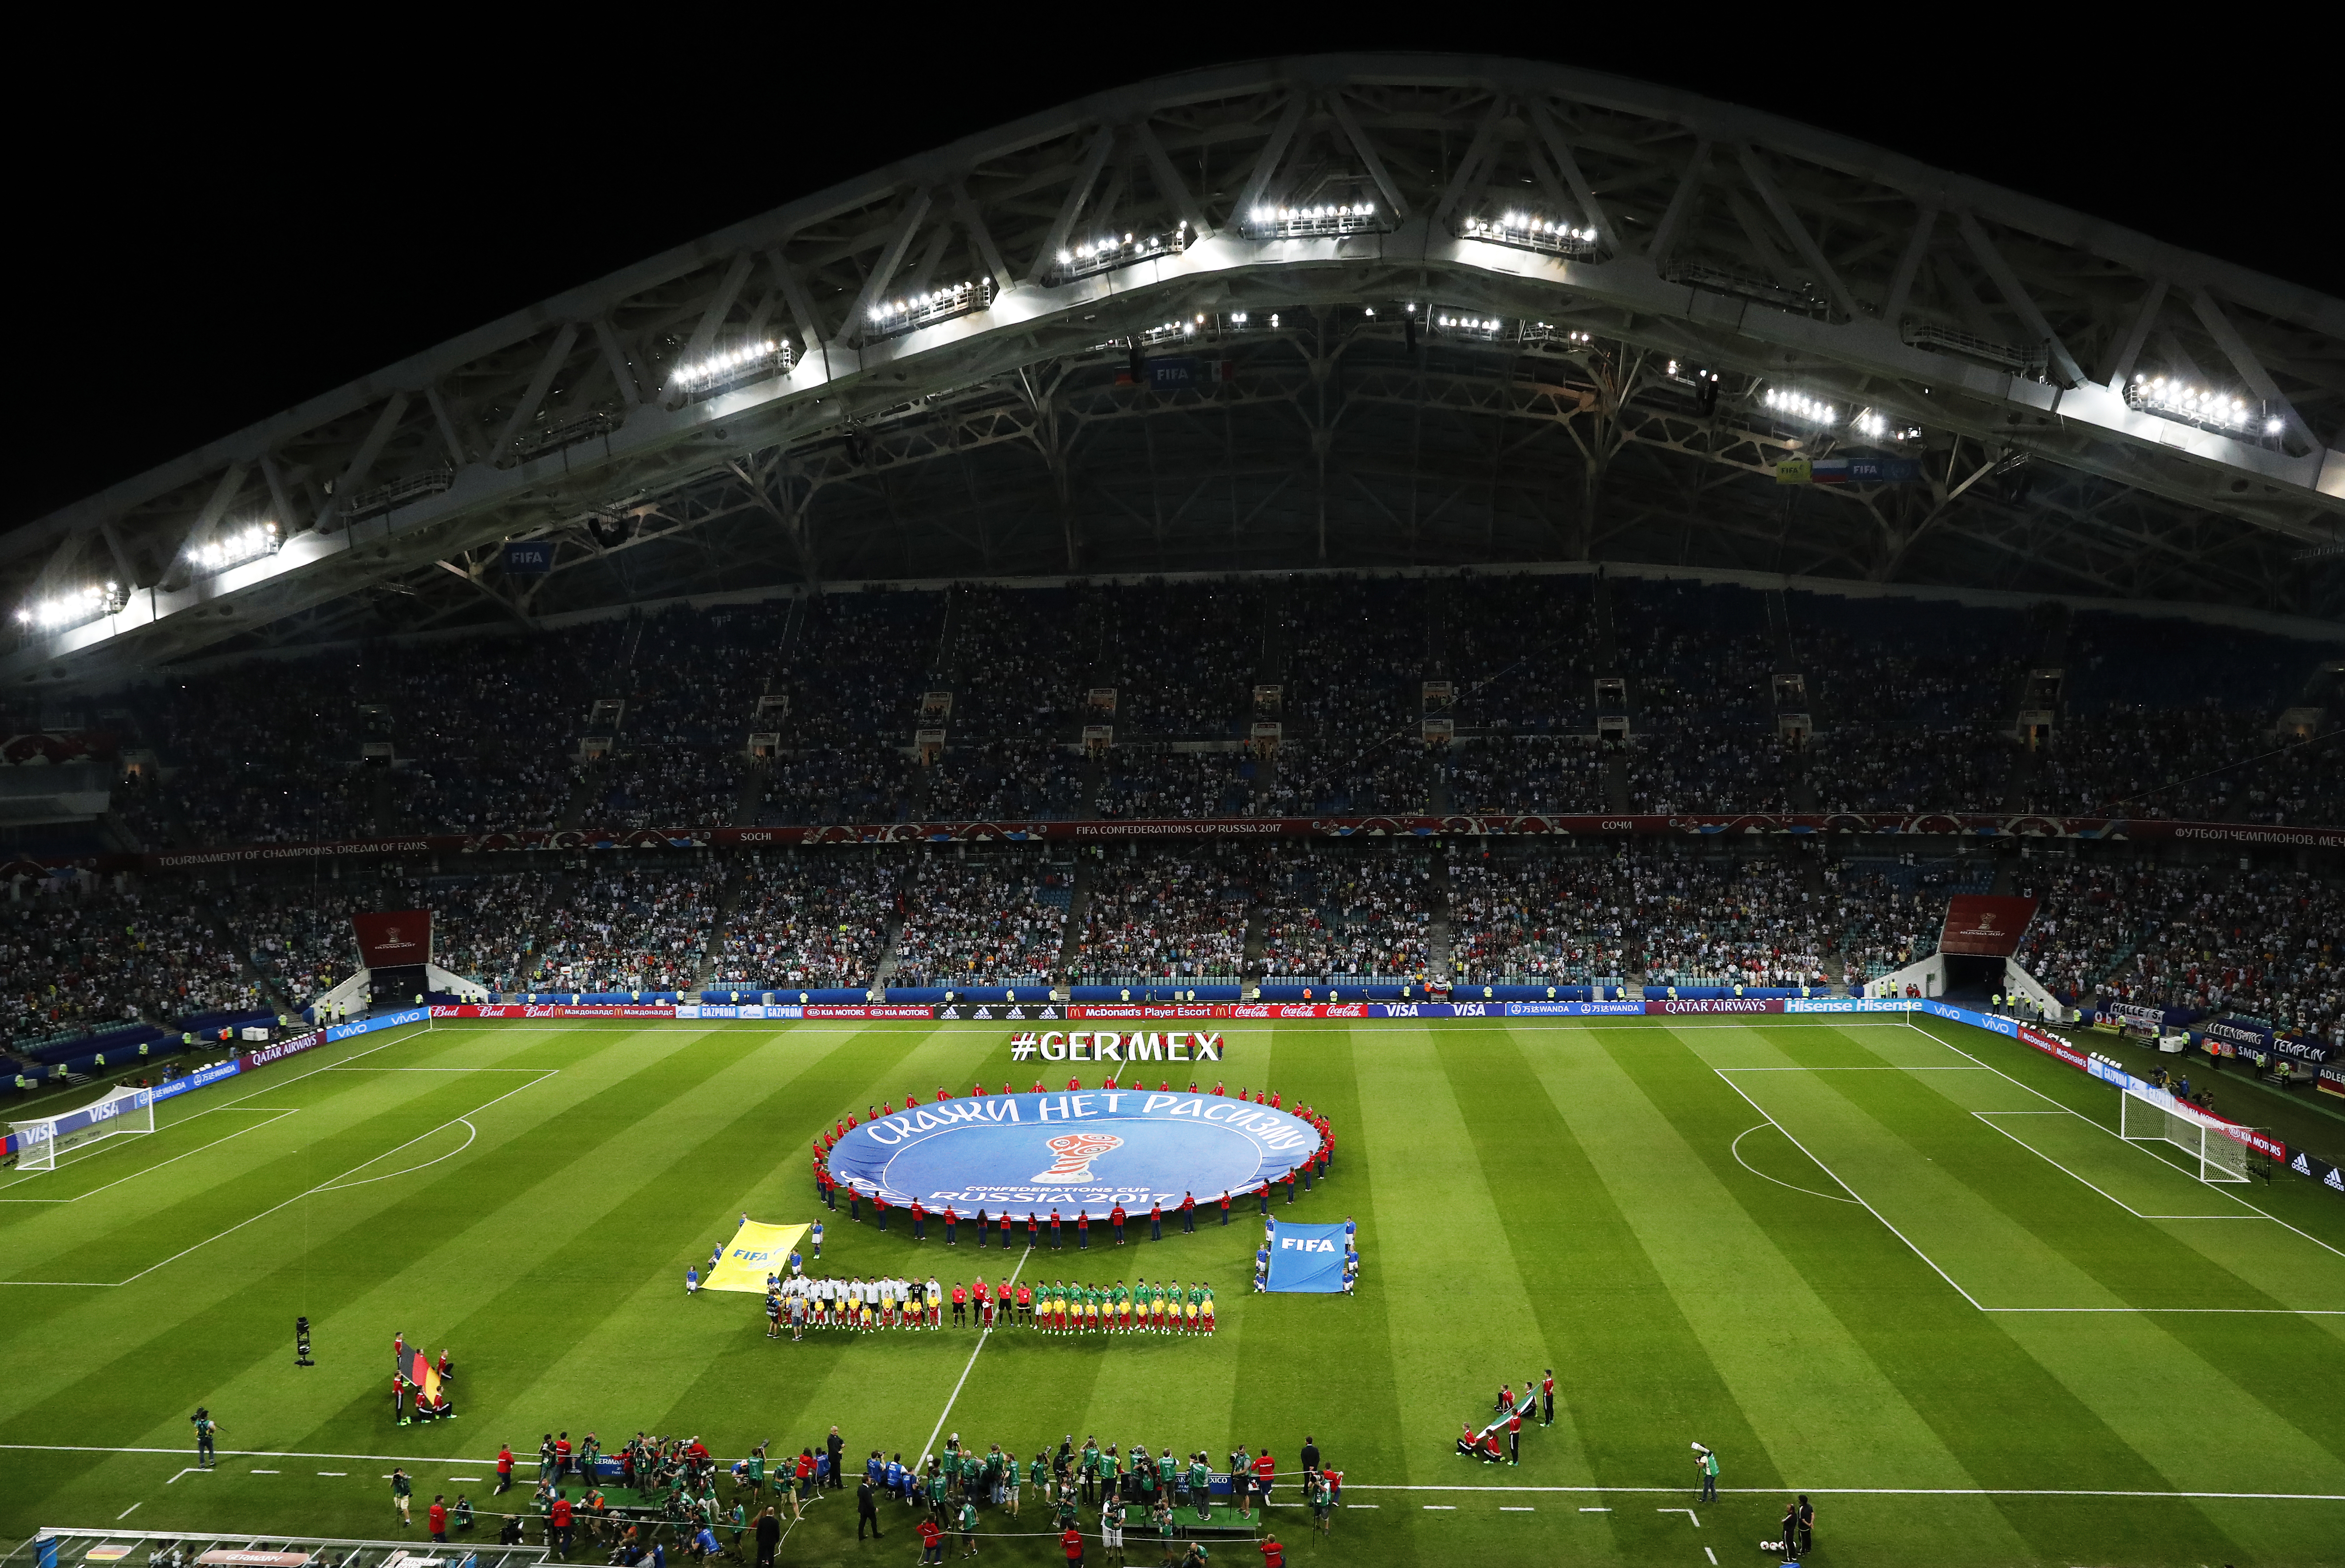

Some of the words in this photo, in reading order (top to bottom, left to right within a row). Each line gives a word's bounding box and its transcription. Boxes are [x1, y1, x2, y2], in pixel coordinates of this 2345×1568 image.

[1157, 368, 1188, 381] FIFA
[1853, 465, 1877, 474] FIFA
[512, 552, 543, 564] FIFA
[1100, 825, 1192, 834] CONFEDERATIONS
[1195, 825, 1216, 833] CUP
[1218, 824, 1256, 833] RUSSIA
[740, 832, 771, 841] SOCHI
[2175, 828, 2227, 839] ФУТБОЛ
[2230, 831, 2316, 845] ЧЕМПИОНОВ.
[159, 851, 242, 867] TOURNAMENT
[245, 850, 259, 860] OF
[263, 846, 336, 859] CHAMPIONS.
[337, 844, 379, 854] DREAM
[381, 843, 395, 851] OF
[398, 841, 430, 850] FANS.
[431, 1005, 459, 1017] Bud
[477, 1005, 505, 1017] Bud
[523, 1005, 552, 1017] Bud
[702, 1008, 736, 1017] GAZPROM
[767, 1008, 802, 1017] GAZPROM
[1086, 1008, 1141, 1017] McDonald's
[1145, 1007, 1175, 1018] Player
[1177, 1007, 1210, 1016] Escort
[1383, 1004, 1419, 1016] VISA
[1450, 1004, 1485, 1016] VISA
[1665, 1001, 1708, 1014] QATAR
[1713, 1000, 1766, 1011] AIRWAYS
[1787, 1000, 1853, 1012] Hisense
[1856, 999, 1923, 1011] Hisense
[2112, 1003, 2145, 1017] HALLE
[253, 1046, 281, 1066] QATAR
[282, 1034, 317, 1055] AIRWAYS
[1011, 1031, 1219, 1061] #GERMEX
[2023, 1032, 2051, 1051] McDonald's
[2056, 1047, 2087, 1068] McDonald's
[2273, 1038, 2325, 1062] TEMPLIN
[2104, 1066, 2127, 1087] GAZPROM
[87, 1102, 119, 1122] VISA
[867, 1098, 1021, 1145] СКАЖИ
[1039, 1093, 1128, 1120] НЕТ
[1142, 1094, 1306, 1150] РАСИЗМУ
[23, 1122, 59, 1145] VISA
[2188, 1107, 2199, 1118] KIA
[2200, 1113, 2225, 1130] MOTORS
[2241, 1131, 2252, 1143] KIA
[2253, 1137, 2281, 1156] MOTORS
[2291, 1162, 2311, 1176] adidas
[2324, 1177, 2345, 1192] adidas
[928, 1192, 1076, 1203] RUSSIA
[1081, 1193, 1175, 1203] 2017
[1282, 1238, 1335, 1252] FIFA
[733, 1249, 768, 1260] FIFA
[226, 1554, 283, 1562] GERMANY
